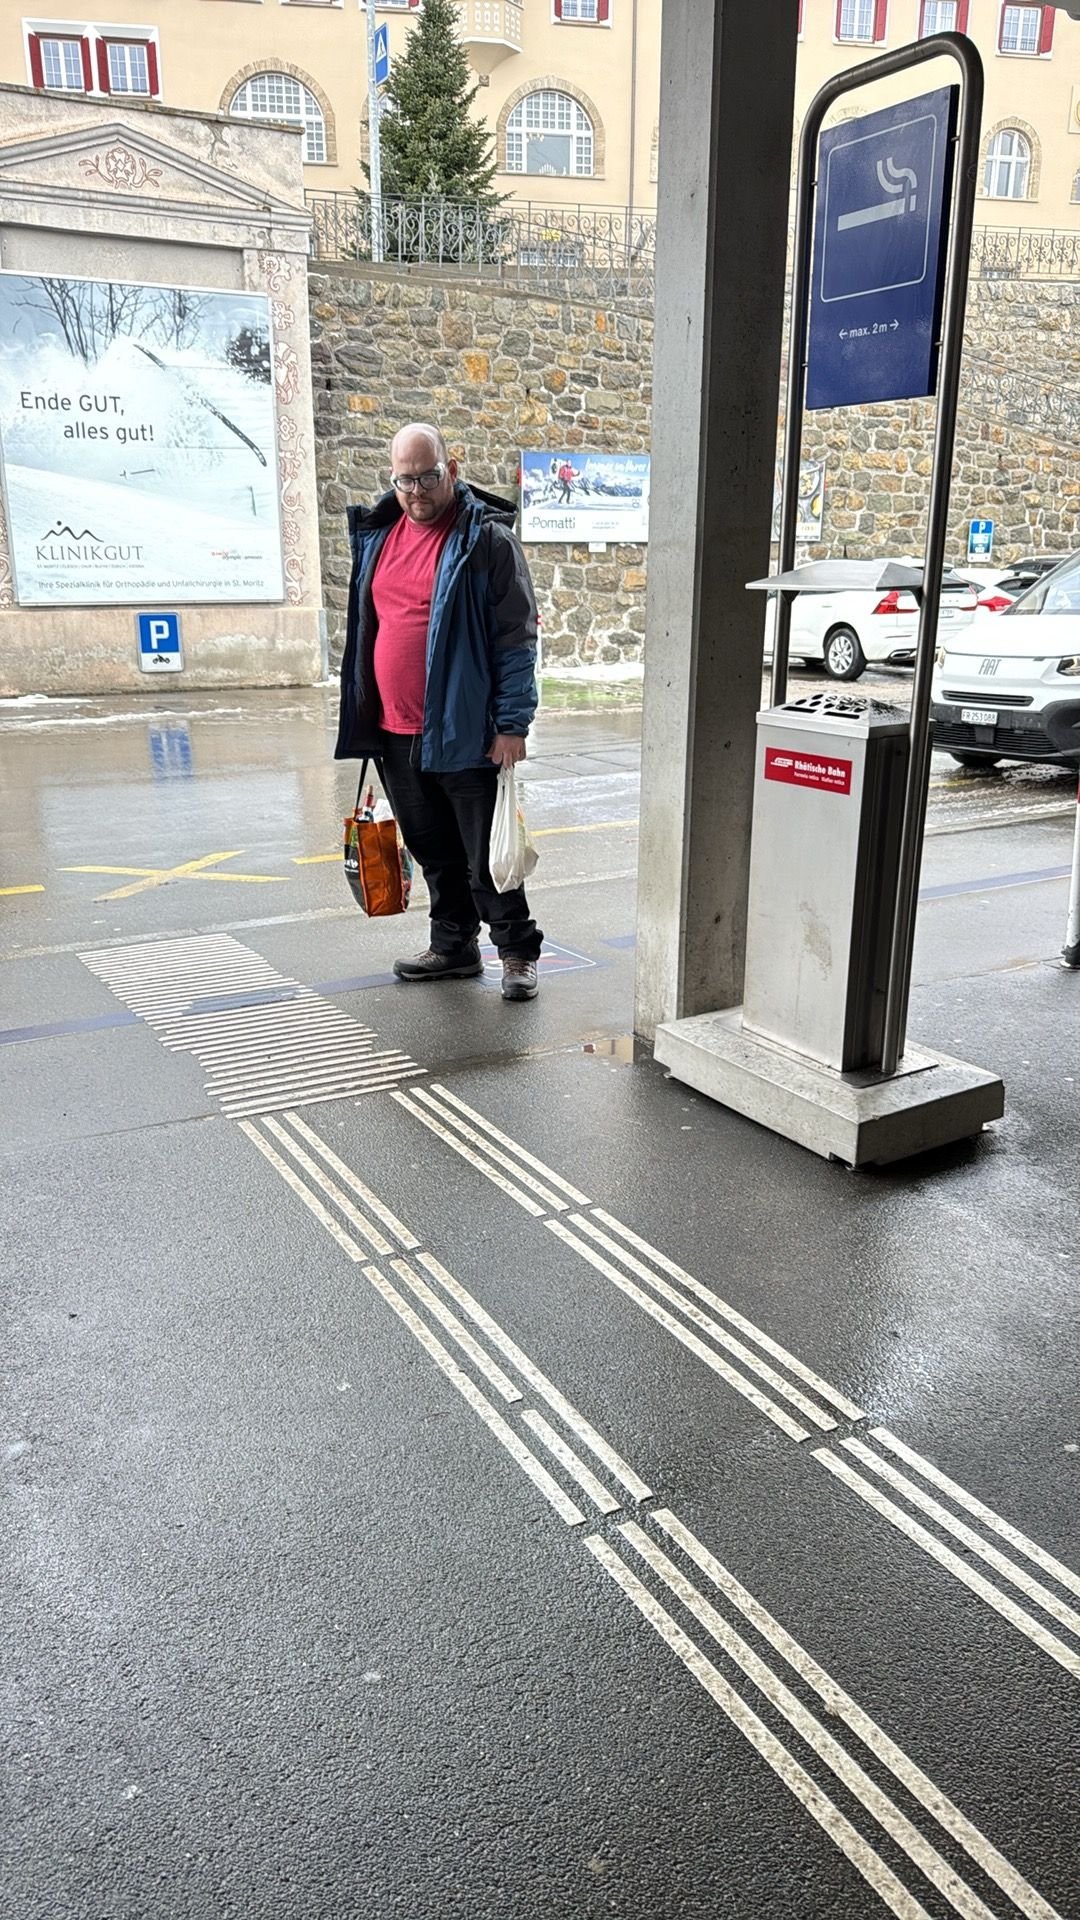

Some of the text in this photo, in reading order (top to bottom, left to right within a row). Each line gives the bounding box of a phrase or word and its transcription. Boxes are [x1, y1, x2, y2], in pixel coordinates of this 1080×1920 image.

[849, 327, 870, 338] max.
[20, 391, 125, 416] Ende GUT,
[63, 421, 155, 444] alles gut!
[532, 516, 576, 529] Pomatti
[978, 520, 987, 534] P
[35, 545, 144, 561] KLINIKGUT
[38, 581, 54, 589] Ihre
[55, 581, 101, 589] Spezialklinik
[102, 580, 114, 589] für
[115, 580, 155, 589] Orthopädie
[157, 580, 171, 588] und
[172, 579, 223, 588] Unfallchirurgie
[224, 579, 232, 588] in
[242, 579, 264, 588] Moritz
[149, 620, 170, 650] P
[978, 658, 1002, 676] FIAT
[795, 760, 826, 774] Rhätische
[828, 766, 845, 777] Bahn
